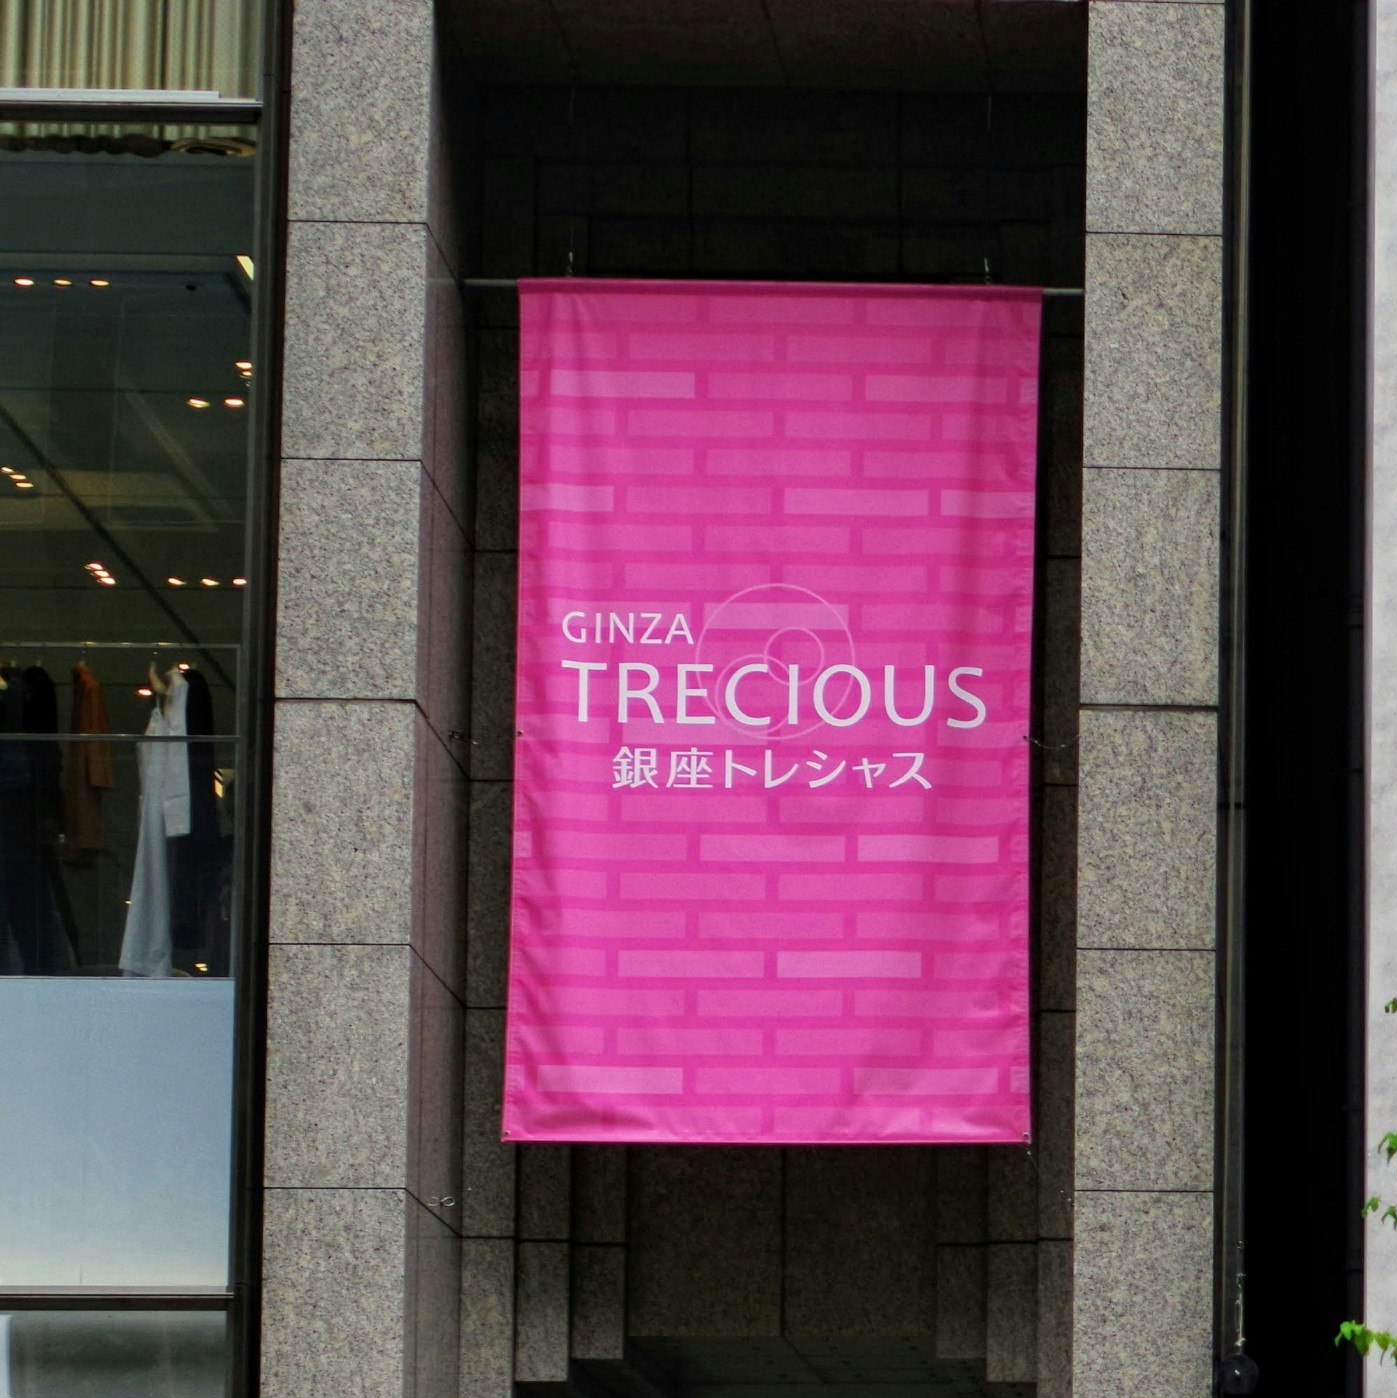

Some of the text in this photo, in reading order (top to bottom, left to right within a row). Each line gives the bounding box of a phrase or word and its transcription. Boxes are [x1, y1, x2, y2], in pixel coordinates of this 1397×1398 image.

[561, 611, 694, 645] GINZA
[561, 659, 987, 729] TRECIOUS
[611, 746, 932, 790] 銀座トレシャス
